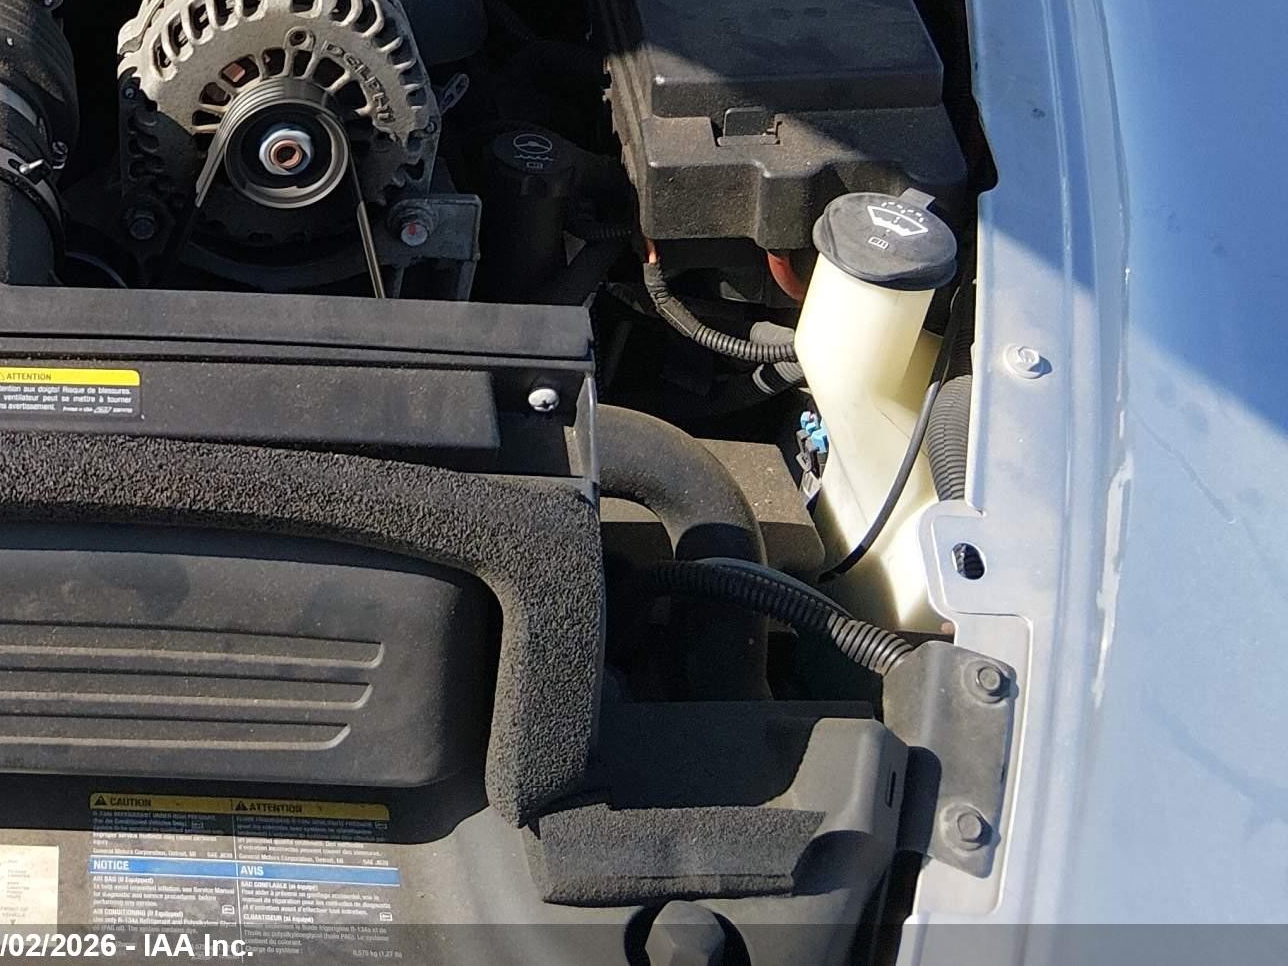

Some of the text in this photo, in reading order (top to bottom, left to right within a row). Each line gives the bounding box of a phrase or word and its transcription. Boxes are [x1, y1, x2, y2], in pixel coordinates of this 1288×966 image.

[43, 395, 58, 403] peut
[110, 797, 151, 807] CAUTION
[249, 803, 302, 813] ATTENTION
[94, 860, 129, 870] NOTICE
[241, 866, 264, 876] AVIS
[104, 908, 145, 916] CONDITIONING
